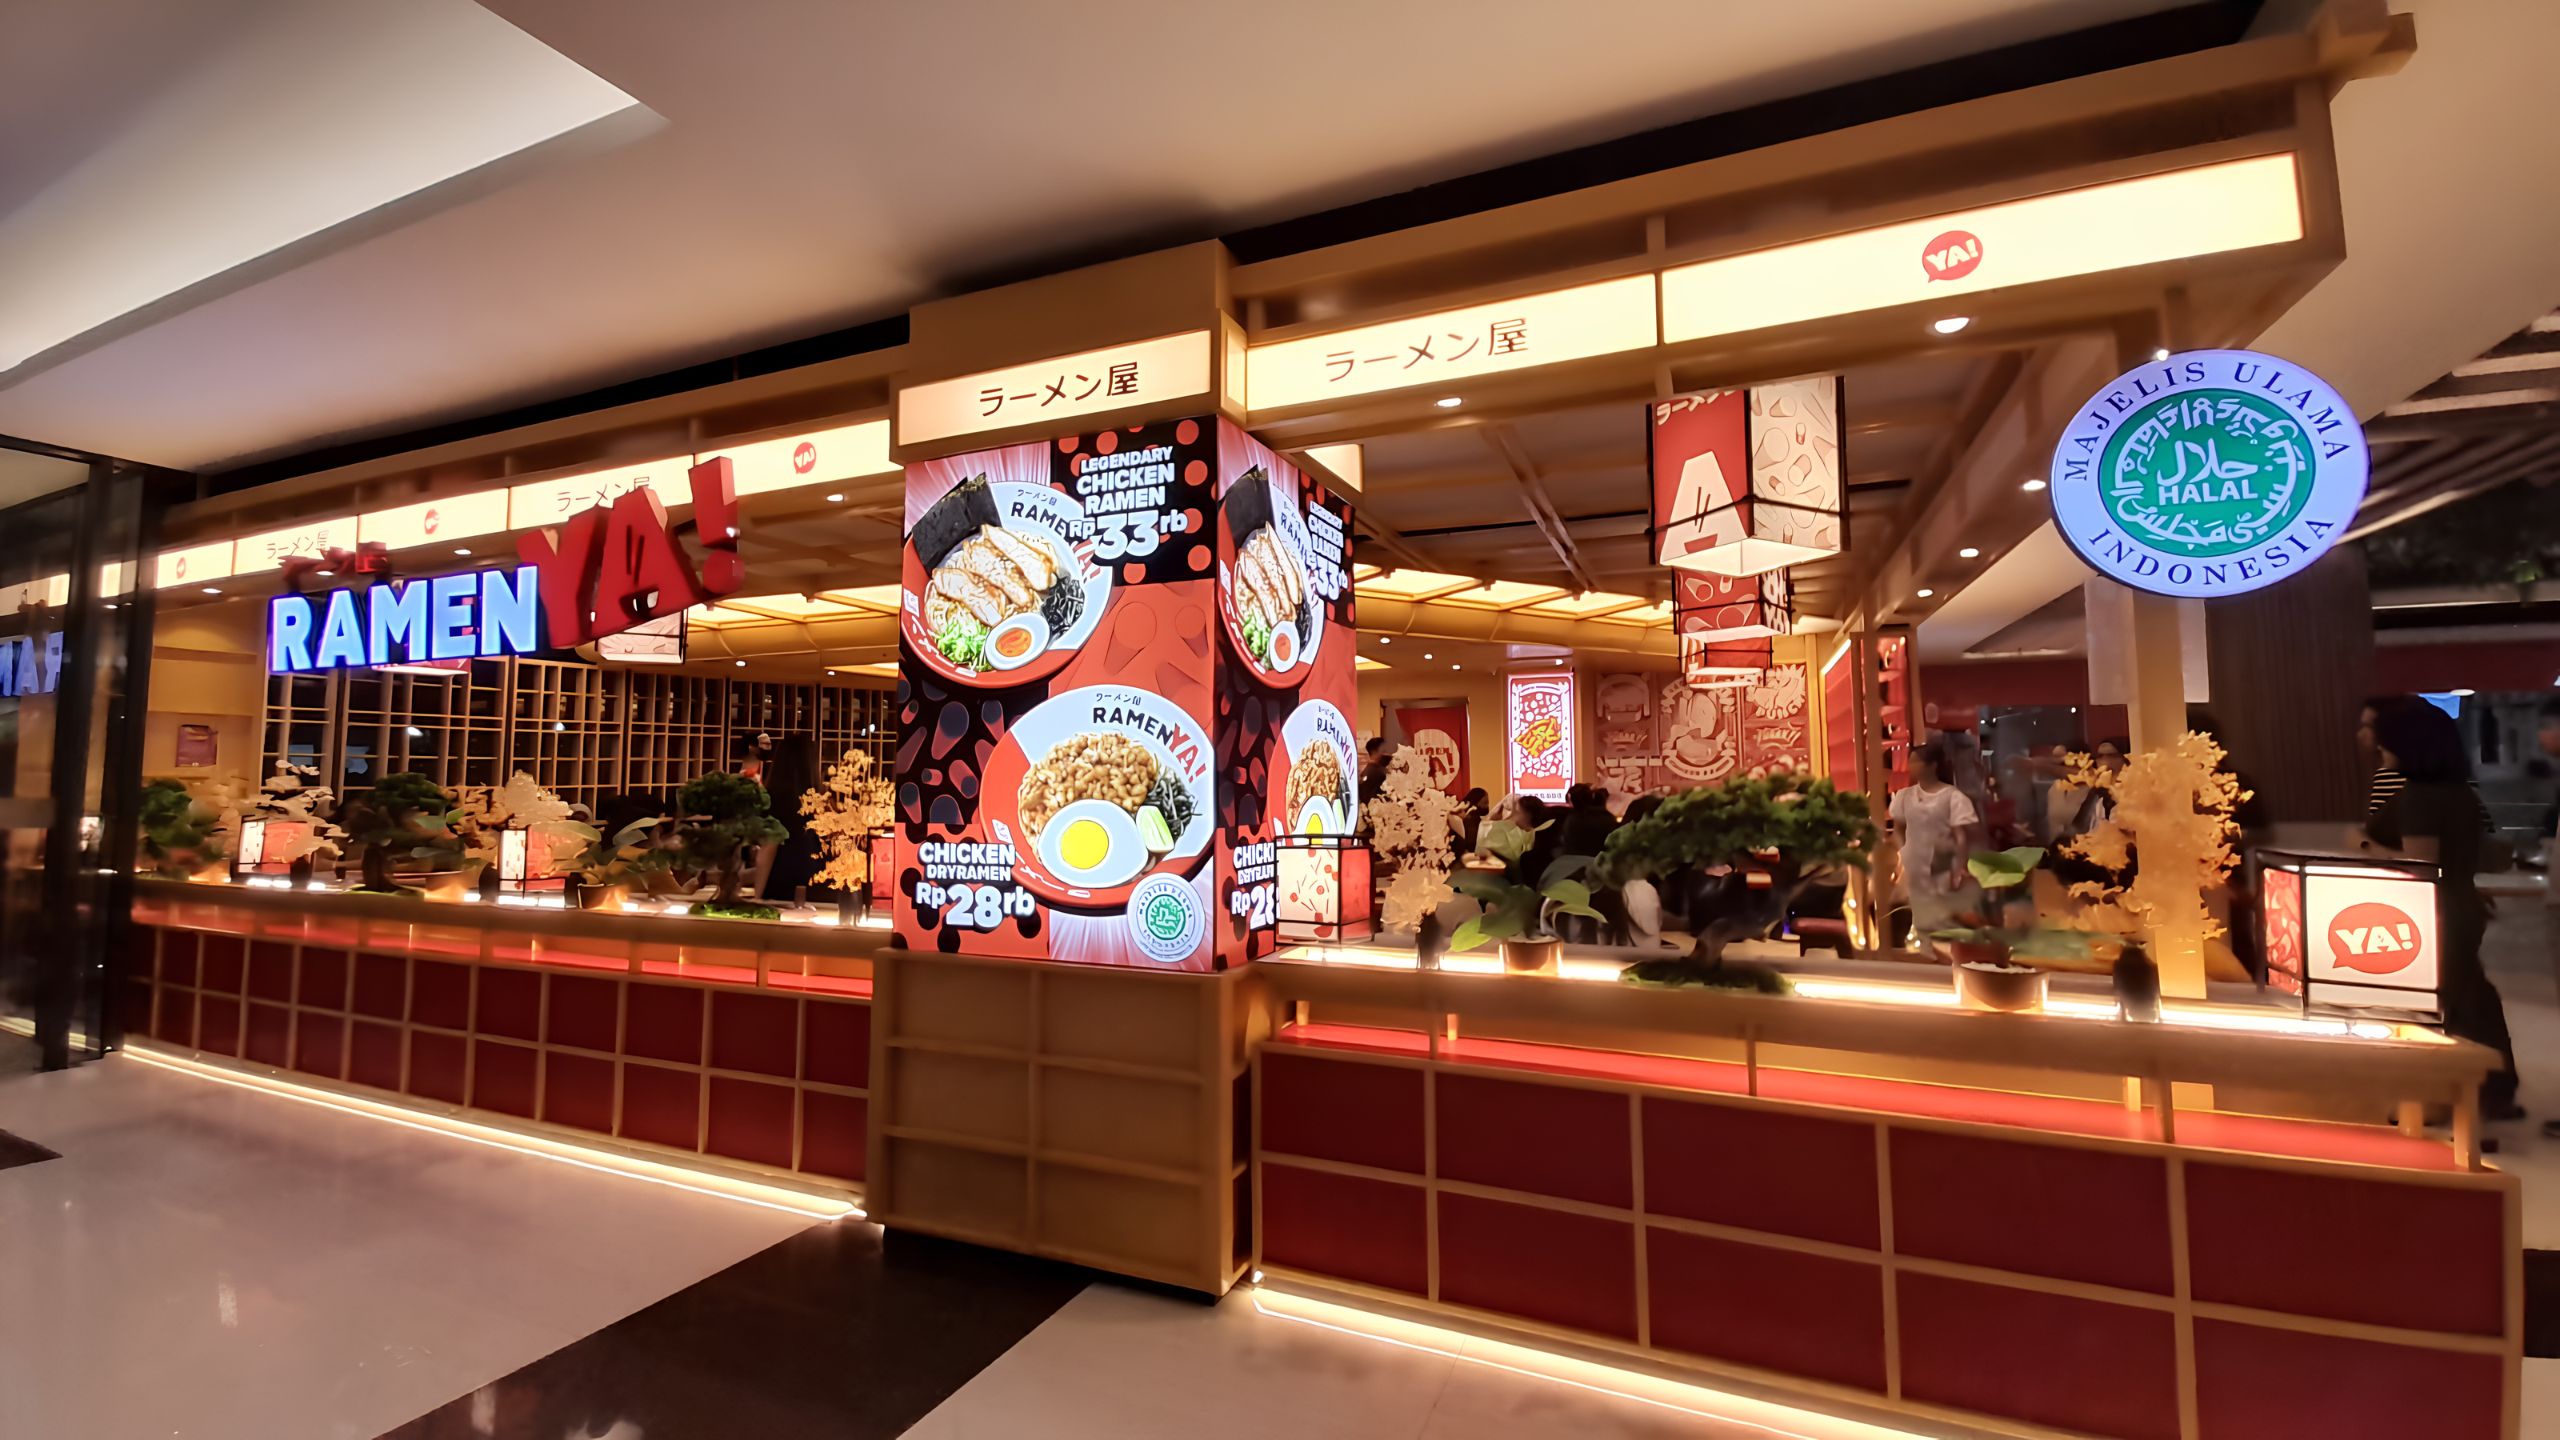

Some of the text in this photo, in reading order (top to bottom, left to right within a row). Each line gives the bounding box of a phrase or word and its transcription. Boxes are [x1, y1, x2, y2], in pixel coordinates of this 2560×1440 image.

[1925, 238, 1979, 272] YA!
[1326, 318, 1528, 382] ラーメン屋
[980, 362, 1139, 416] ラーメン屋
[2064, 362, 2350, 481] MAJELIS ULAMA
[1081, 446, 1173, 474] LEGENDARY
[1076, 463, 1175, 495] CHICKEN
[2158, 479, 2259, 505] HALAL
[1085, 486, 1166, 515] RAMEN
[270, 565, 538, 672] RAMEN
[516, 456, 745, 649] YA!
[2089, 518, 2335, 585] INDONESIA
[919, 842, 1016, 866] CHICKEN
[927, 864, 1011, 882] DRYRAMEN
[2335, 922, 2414, 955] YA!
